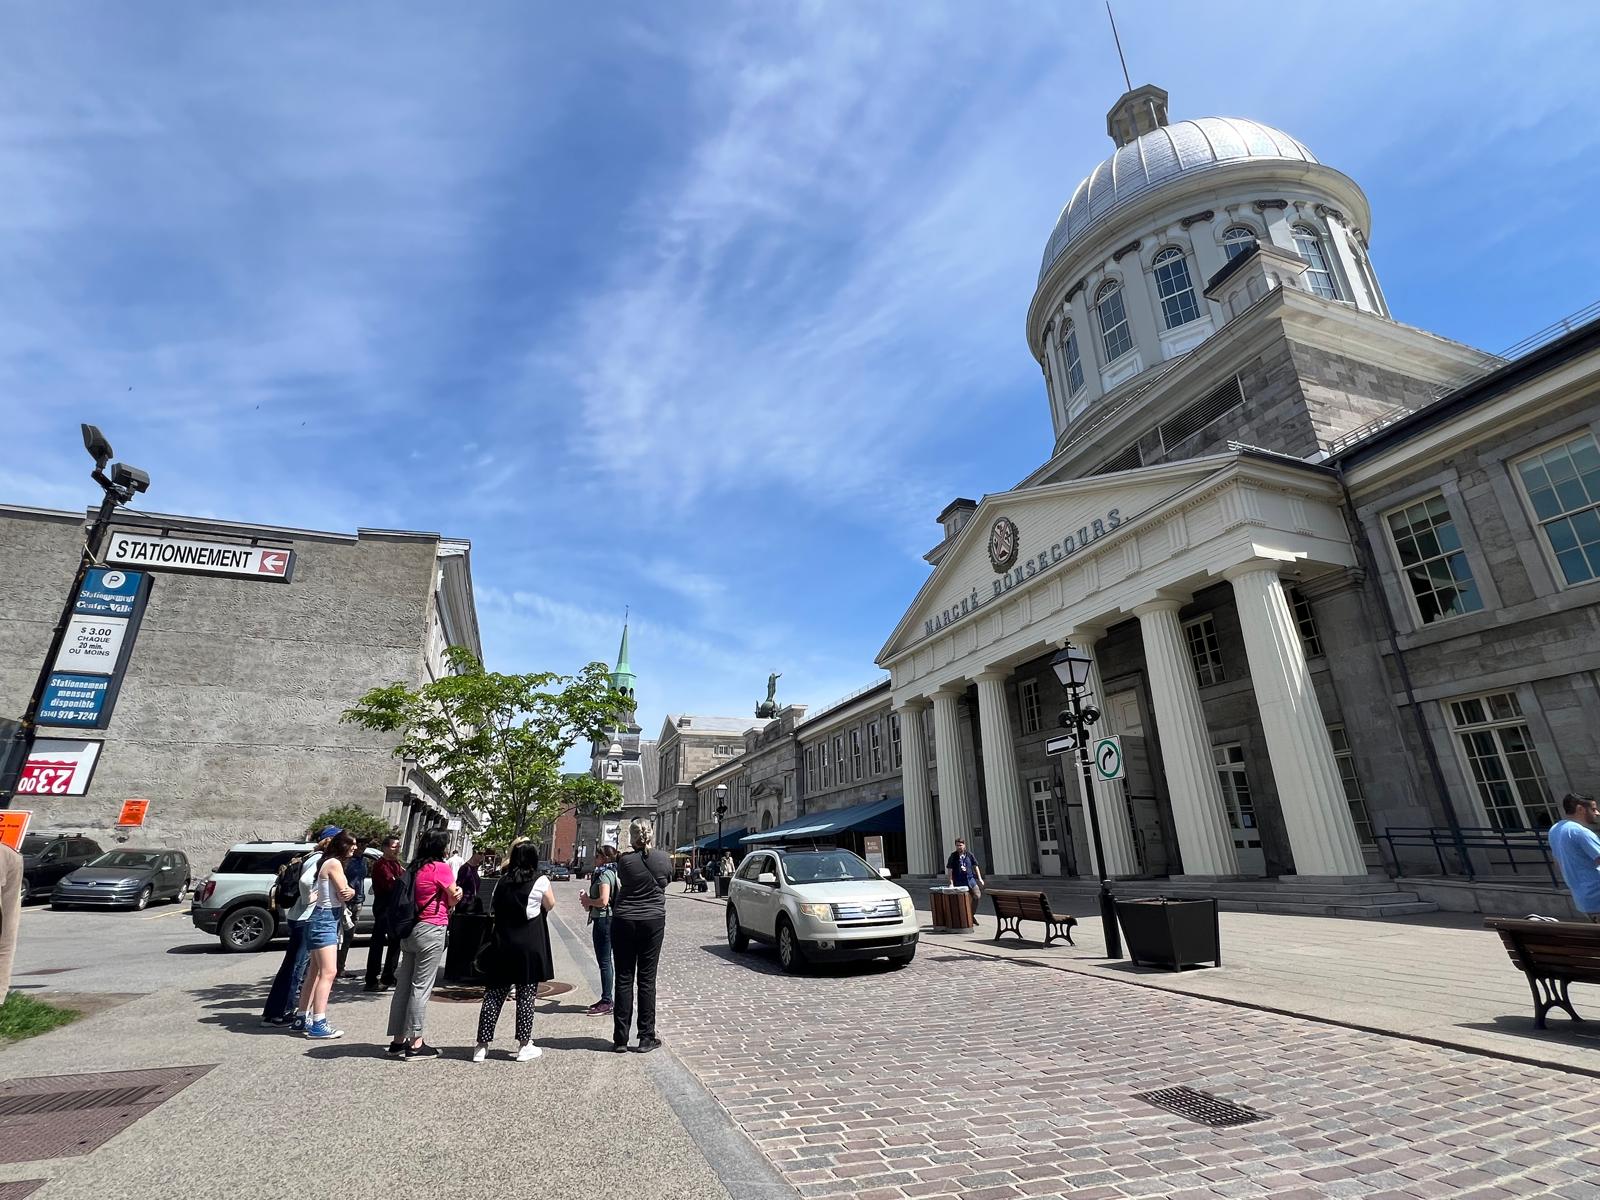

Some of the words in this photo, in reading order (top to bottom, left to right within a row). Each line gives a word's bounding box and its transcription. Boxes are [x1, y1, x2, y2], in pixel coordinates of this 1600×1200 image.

[115, 539, 253, 569] STATIONNEMENT
[108, 575, 120, 585] P
[924, 587, 979, 636] MARCHÉ
[81, 626, 87, 634] $
[88, 627, 112, 636] 3.00
[77, 635, 111, 643] CHAQUE
[84, 649, 110, 657] MOINS
[50, 678, 108, 690] Stationnement
[57, 690, 96, 699] mensuel
[50, 698, 95, 709] disponible
[40, 710, 57, 718] (514)
